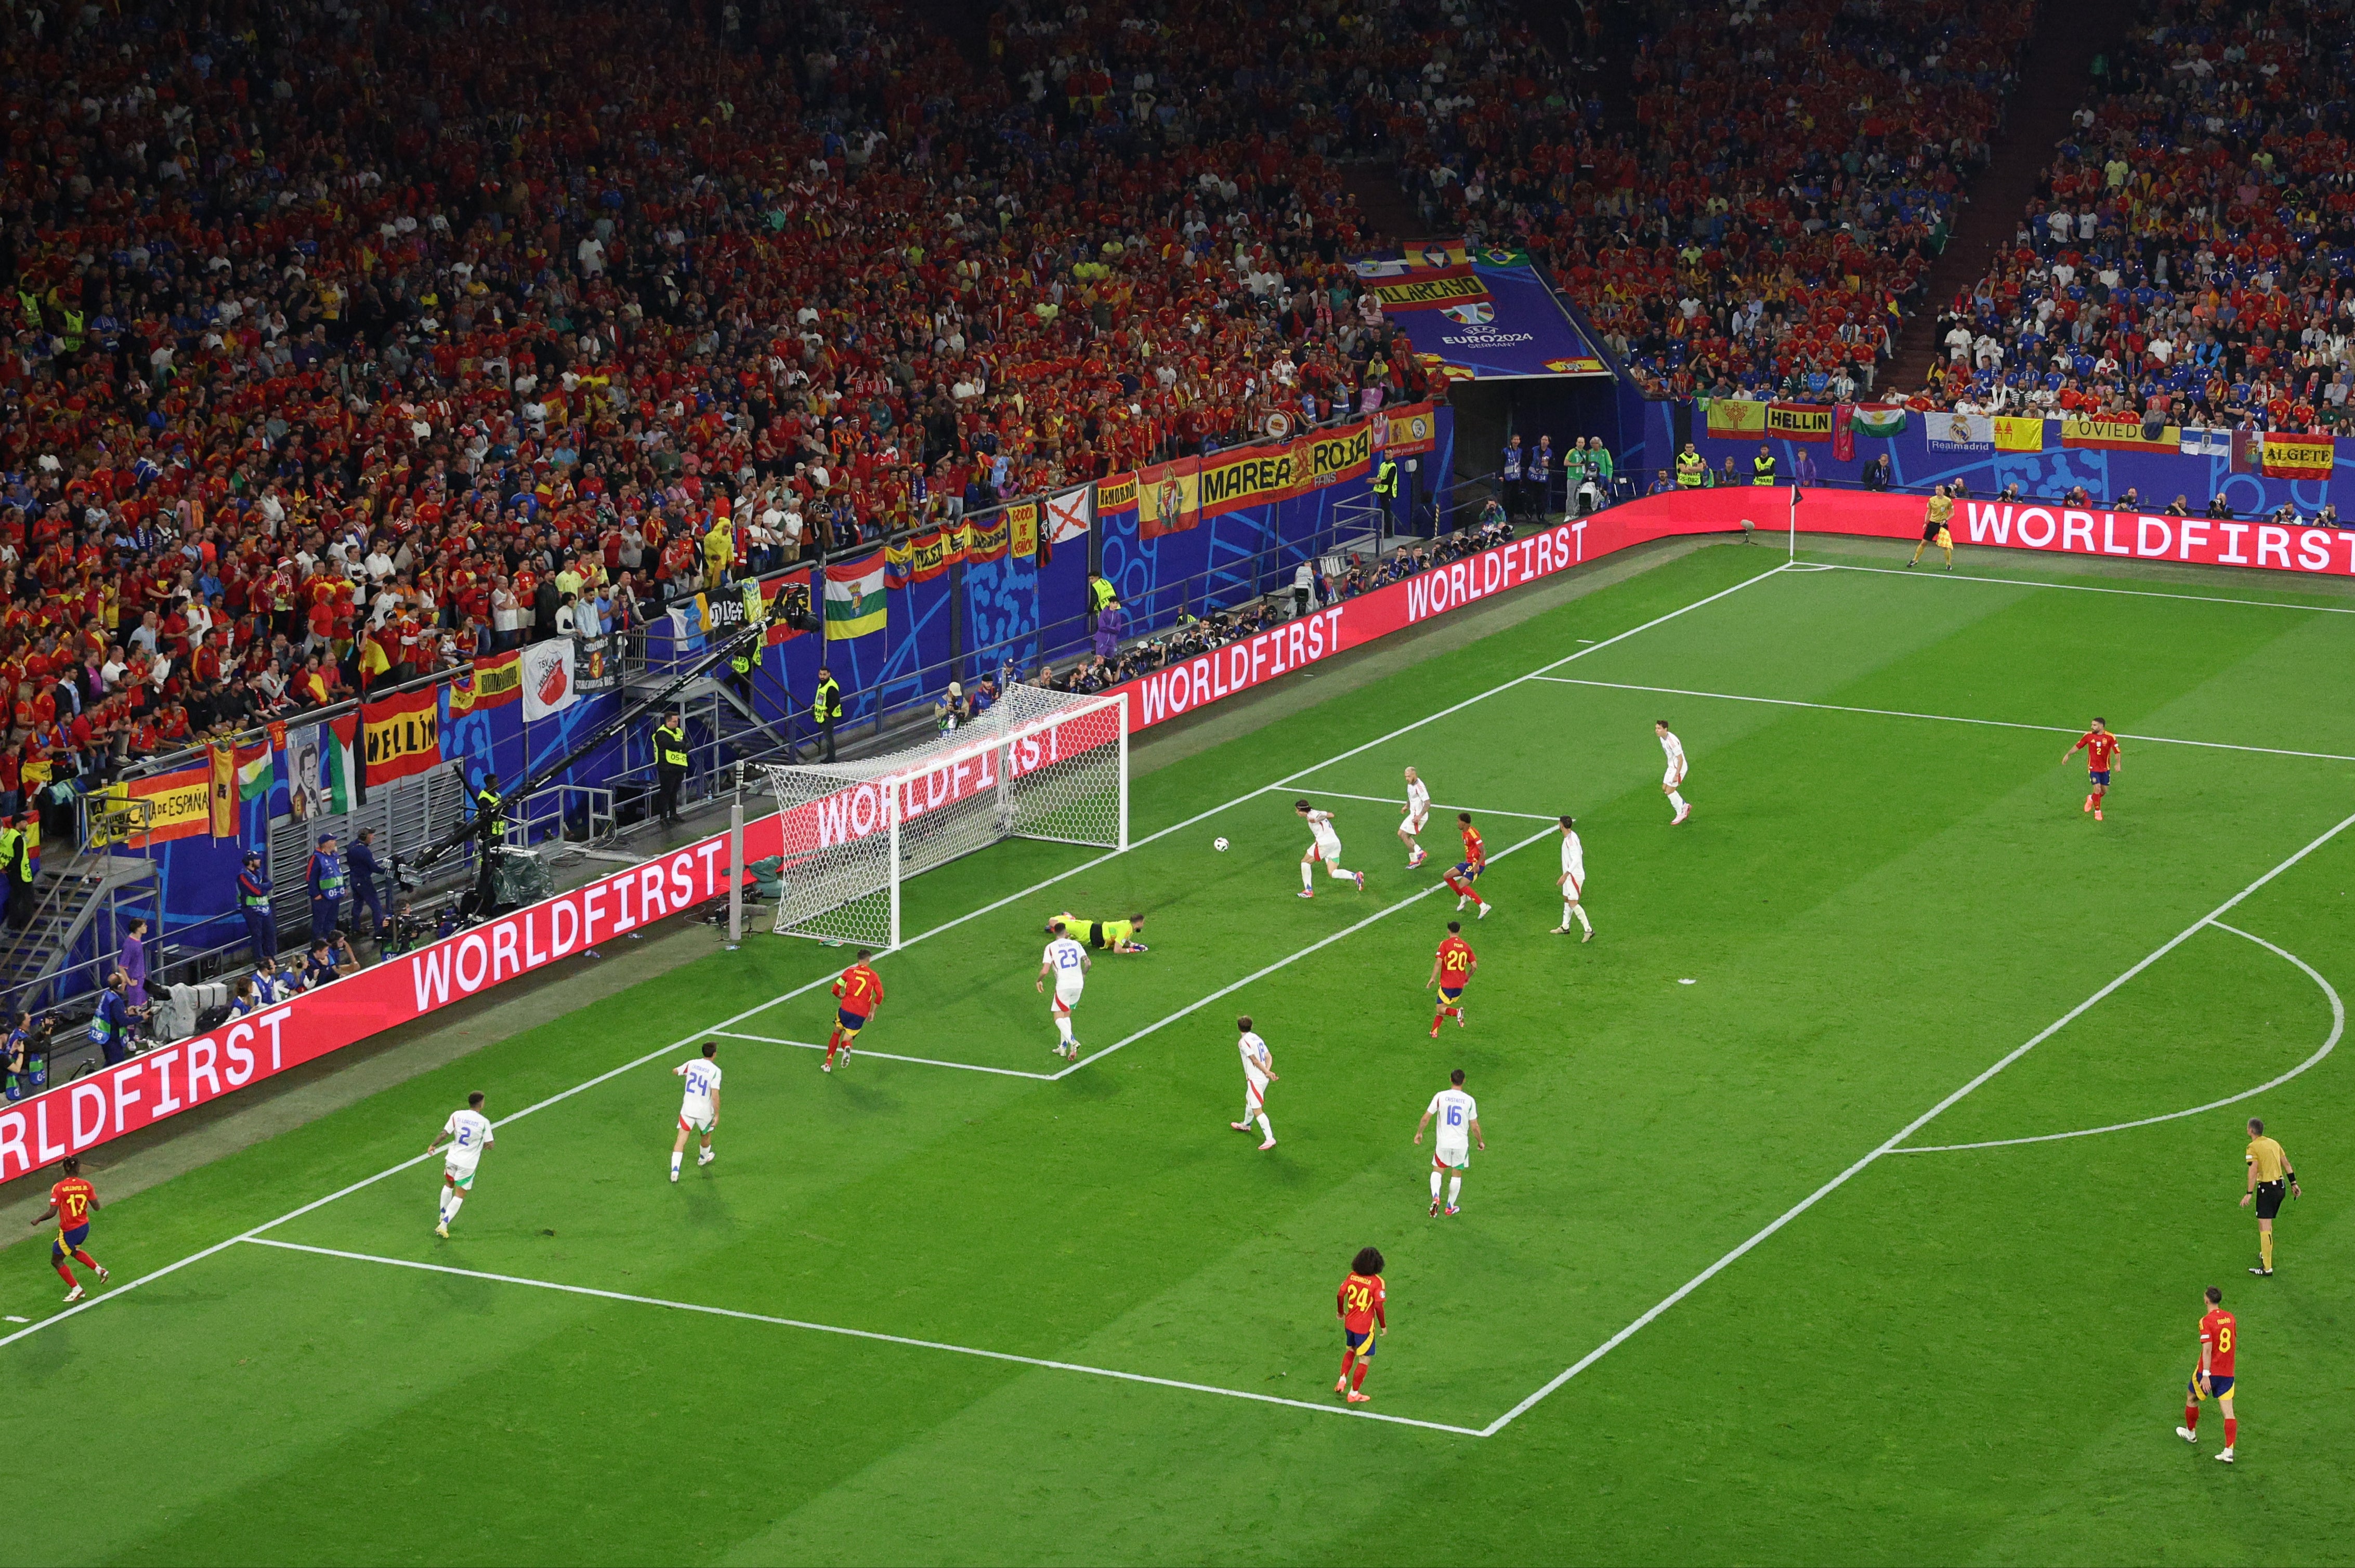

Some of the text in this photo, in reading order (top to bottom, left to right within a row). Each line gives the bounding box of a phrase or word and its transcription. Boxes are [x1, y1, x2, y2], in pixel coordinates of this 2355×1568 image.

[1442, 333, 1533, 344] EURO2024
[1771, 411, 1828, 430] HELLÍN
[1314, 431, 1369, 474] ROJA
[2266, 448, 2331, 463] ALGETE
[1205, 457, 1291, 503] MAREA
[1314, 472, 1337, 487] FANS
[1019, 523, 1027, 537] DE
[1407, 520, 1588, 622] WORLDFIRST
[1142, 607, 1344, 724] WORLDFIRST
[169, 788, 208, 816] ESPAÑA
[412, 840, 723, 1012] WORLDFIRST
[1058, 948, 1078, 969] 23
[1447, 950, 1468, 971] 20
[854, 976, 867, 997] 7
[1257, 1042, 1265, 1062] 18
[686, 1072, 708, 1097] 24
[1447, 1105, 1462, 1126] 16
[459, 1127, 471, 1147] 2
[67, 1194, 87, 1217] 17
[1347, 1284, 1369, 1312] 24
[2218, 1327, 2231, 1353] 8
